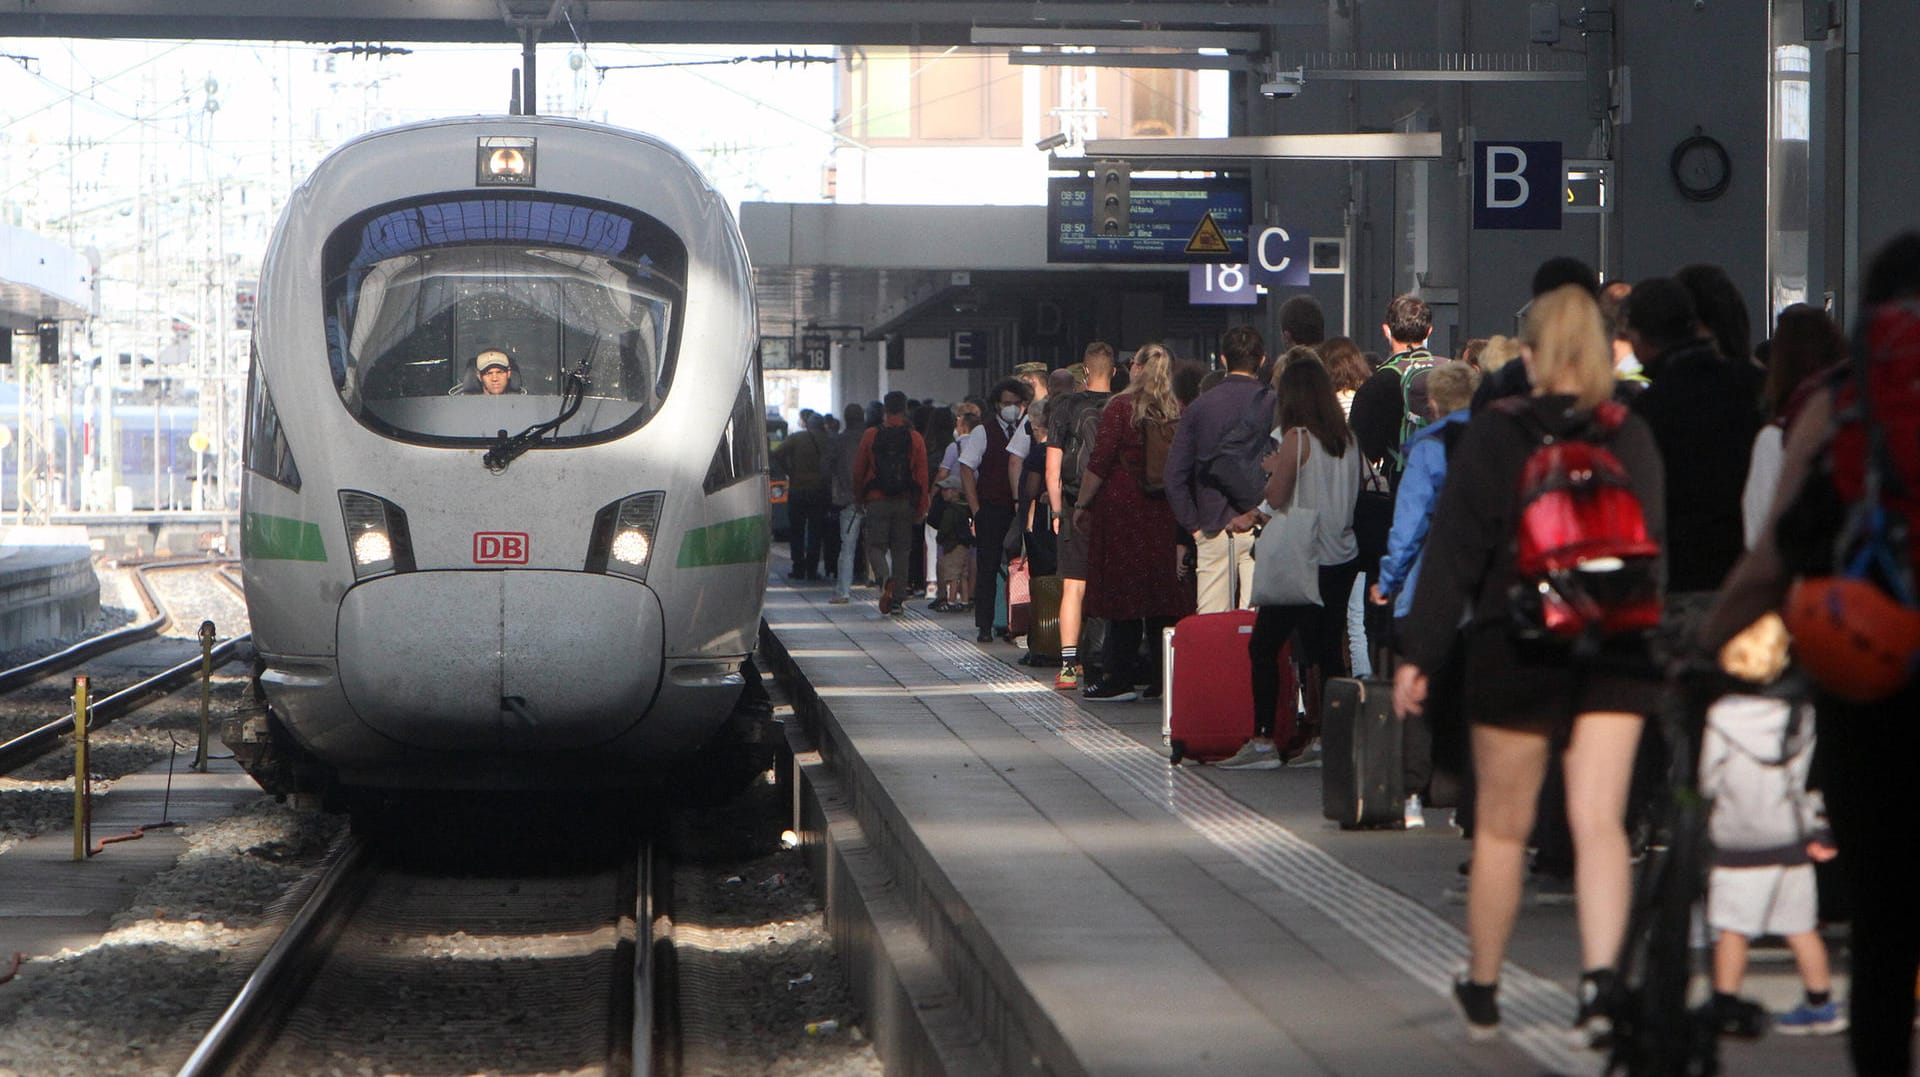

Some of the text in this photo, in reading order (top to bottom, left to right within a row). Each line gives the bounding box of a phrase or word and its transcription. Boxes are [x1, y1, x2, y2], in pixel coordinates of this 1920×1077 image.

[1486, 145, 1530, 208] B
[1061, 191, 1086, 200] 08:50
[1061, 223, 1086, 232] 08:50
[1258, 226, 1290, 272] C
[1206, 263, 1244, 292] 18
[955, 331, 972, 360] E
[807, 350, 825, 369] 18
[480, 536, 523, 559] DB
